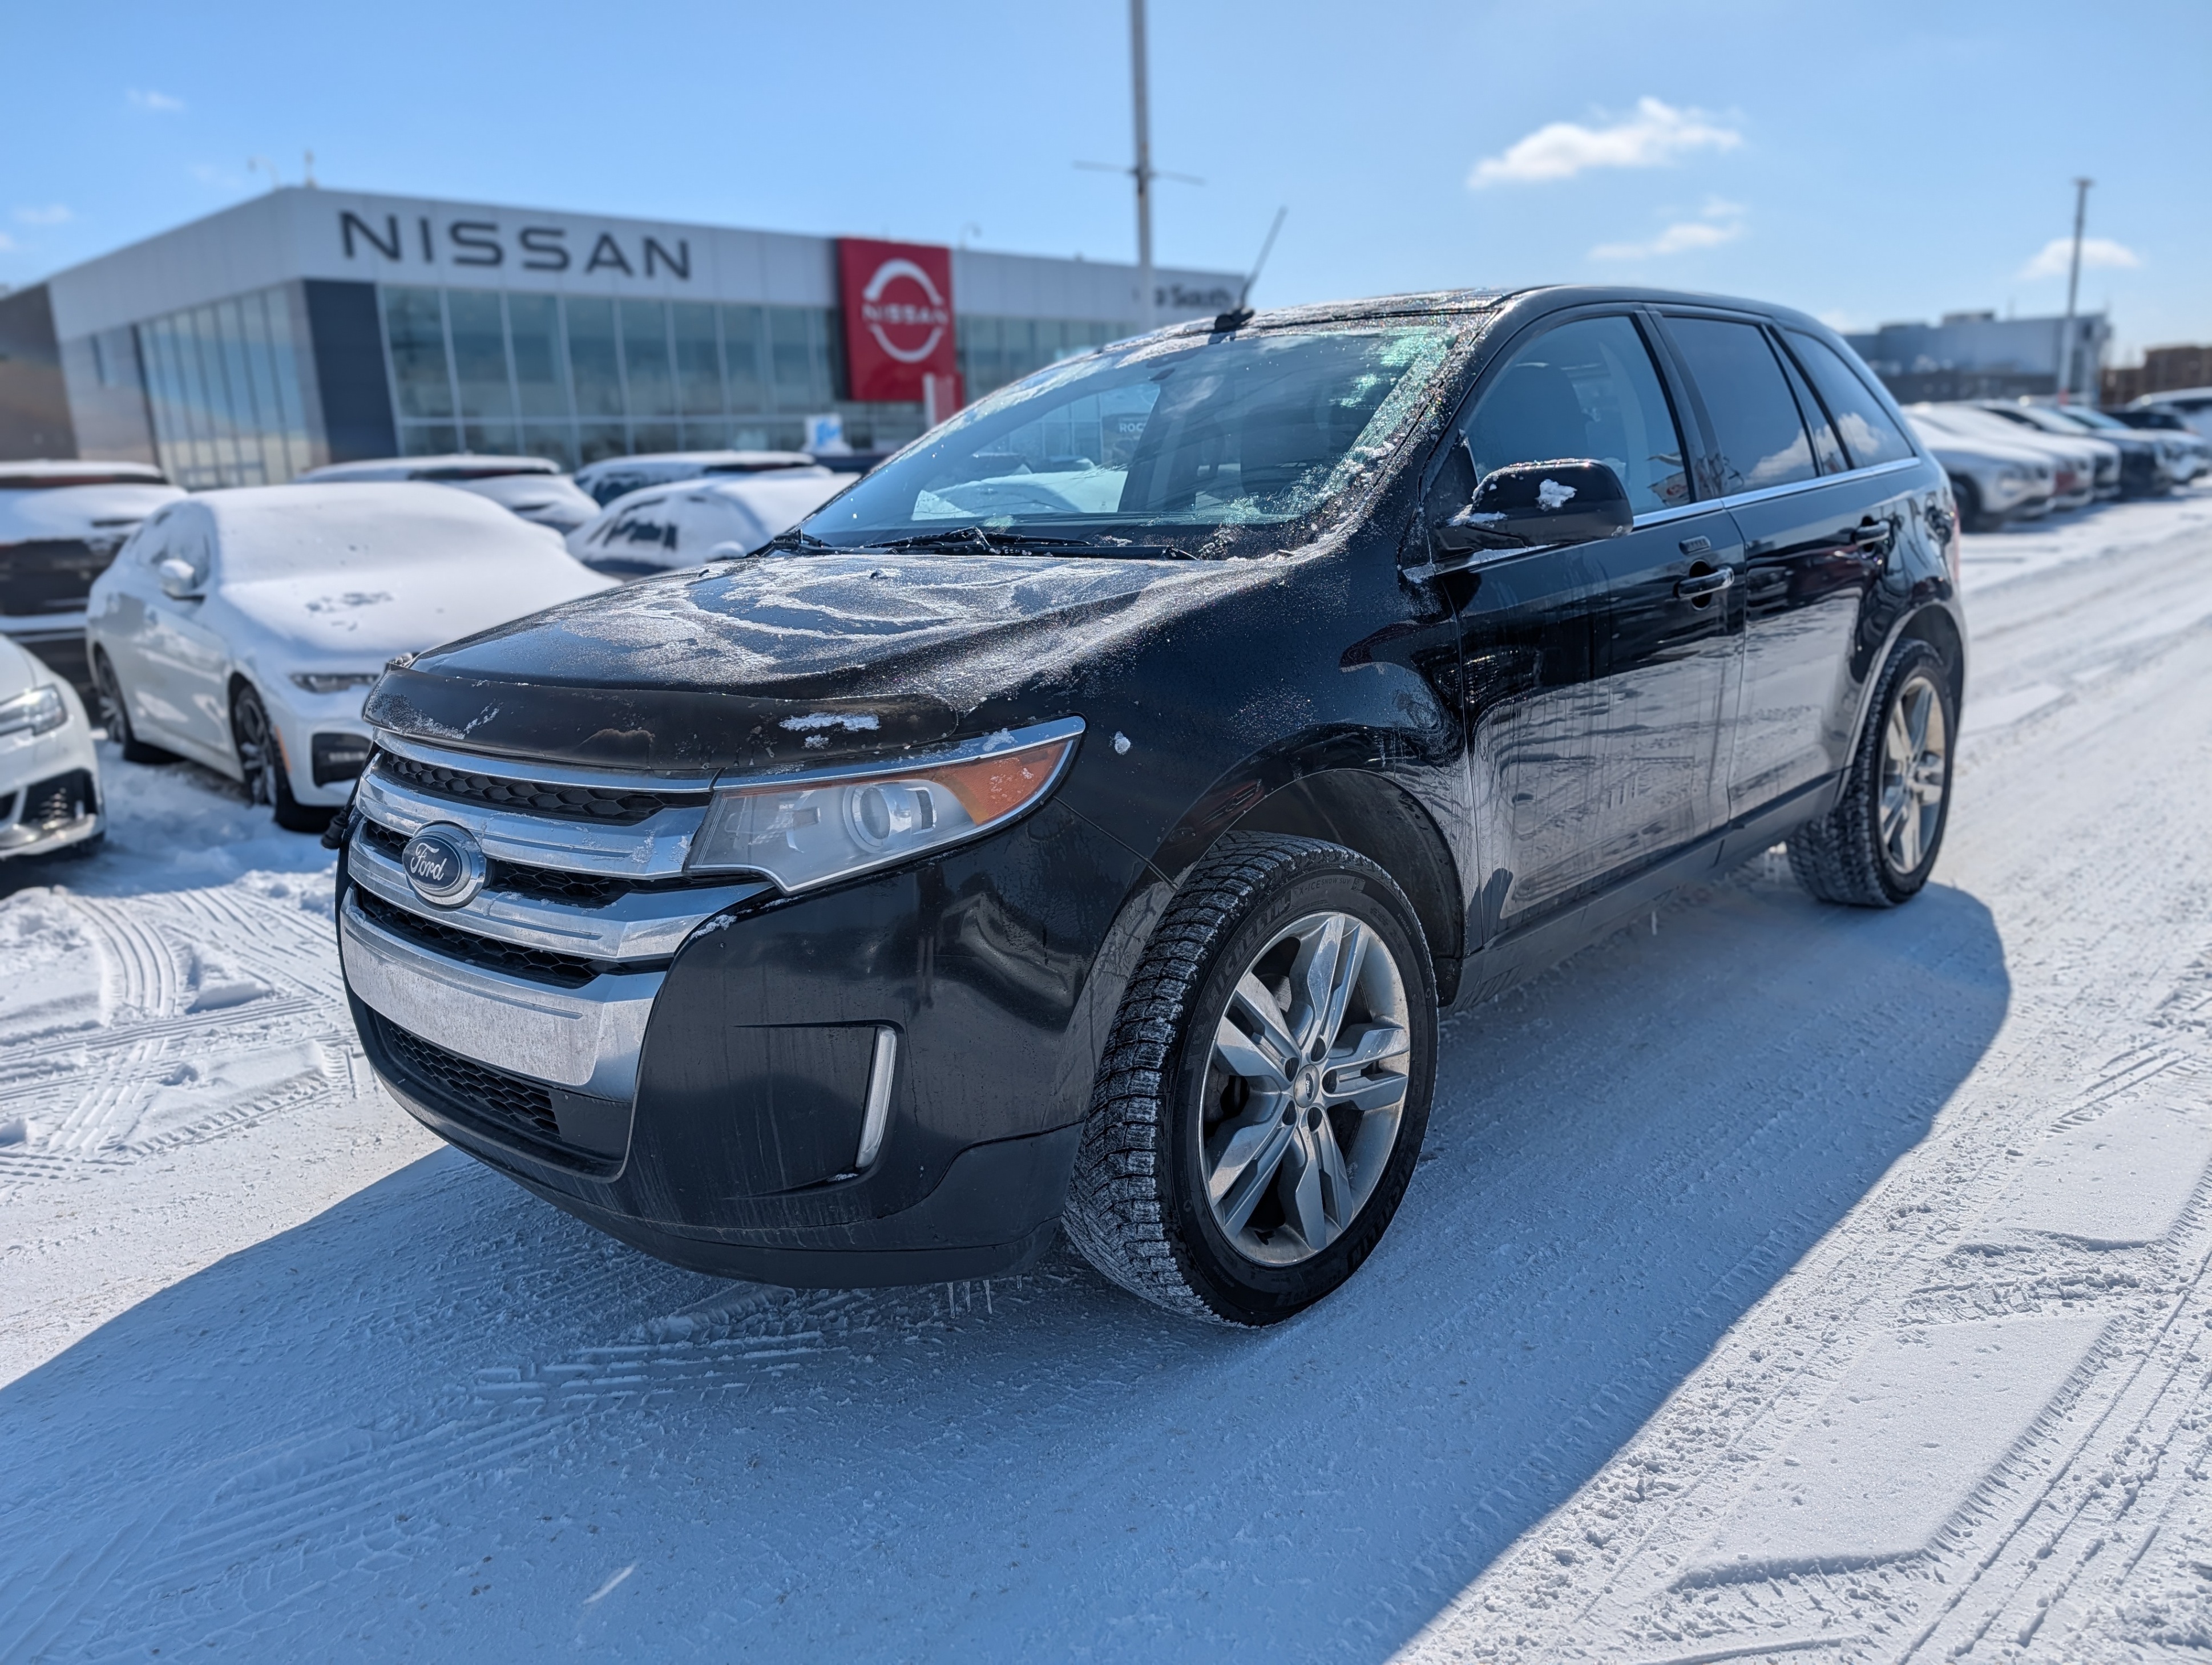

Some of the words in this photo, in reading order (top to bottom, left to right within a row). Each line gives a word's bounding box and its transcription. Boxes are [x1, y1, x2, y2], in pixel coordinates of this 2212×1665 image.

[339, 209, 692, 281] NISSAN
[861, 302, 950, 325] NISSAN
[410, 842, 447, 880] Ford
[1298, 880, 1321, 896] X-ICE
[1205, 895, 1291, 1015] MICHELIN
